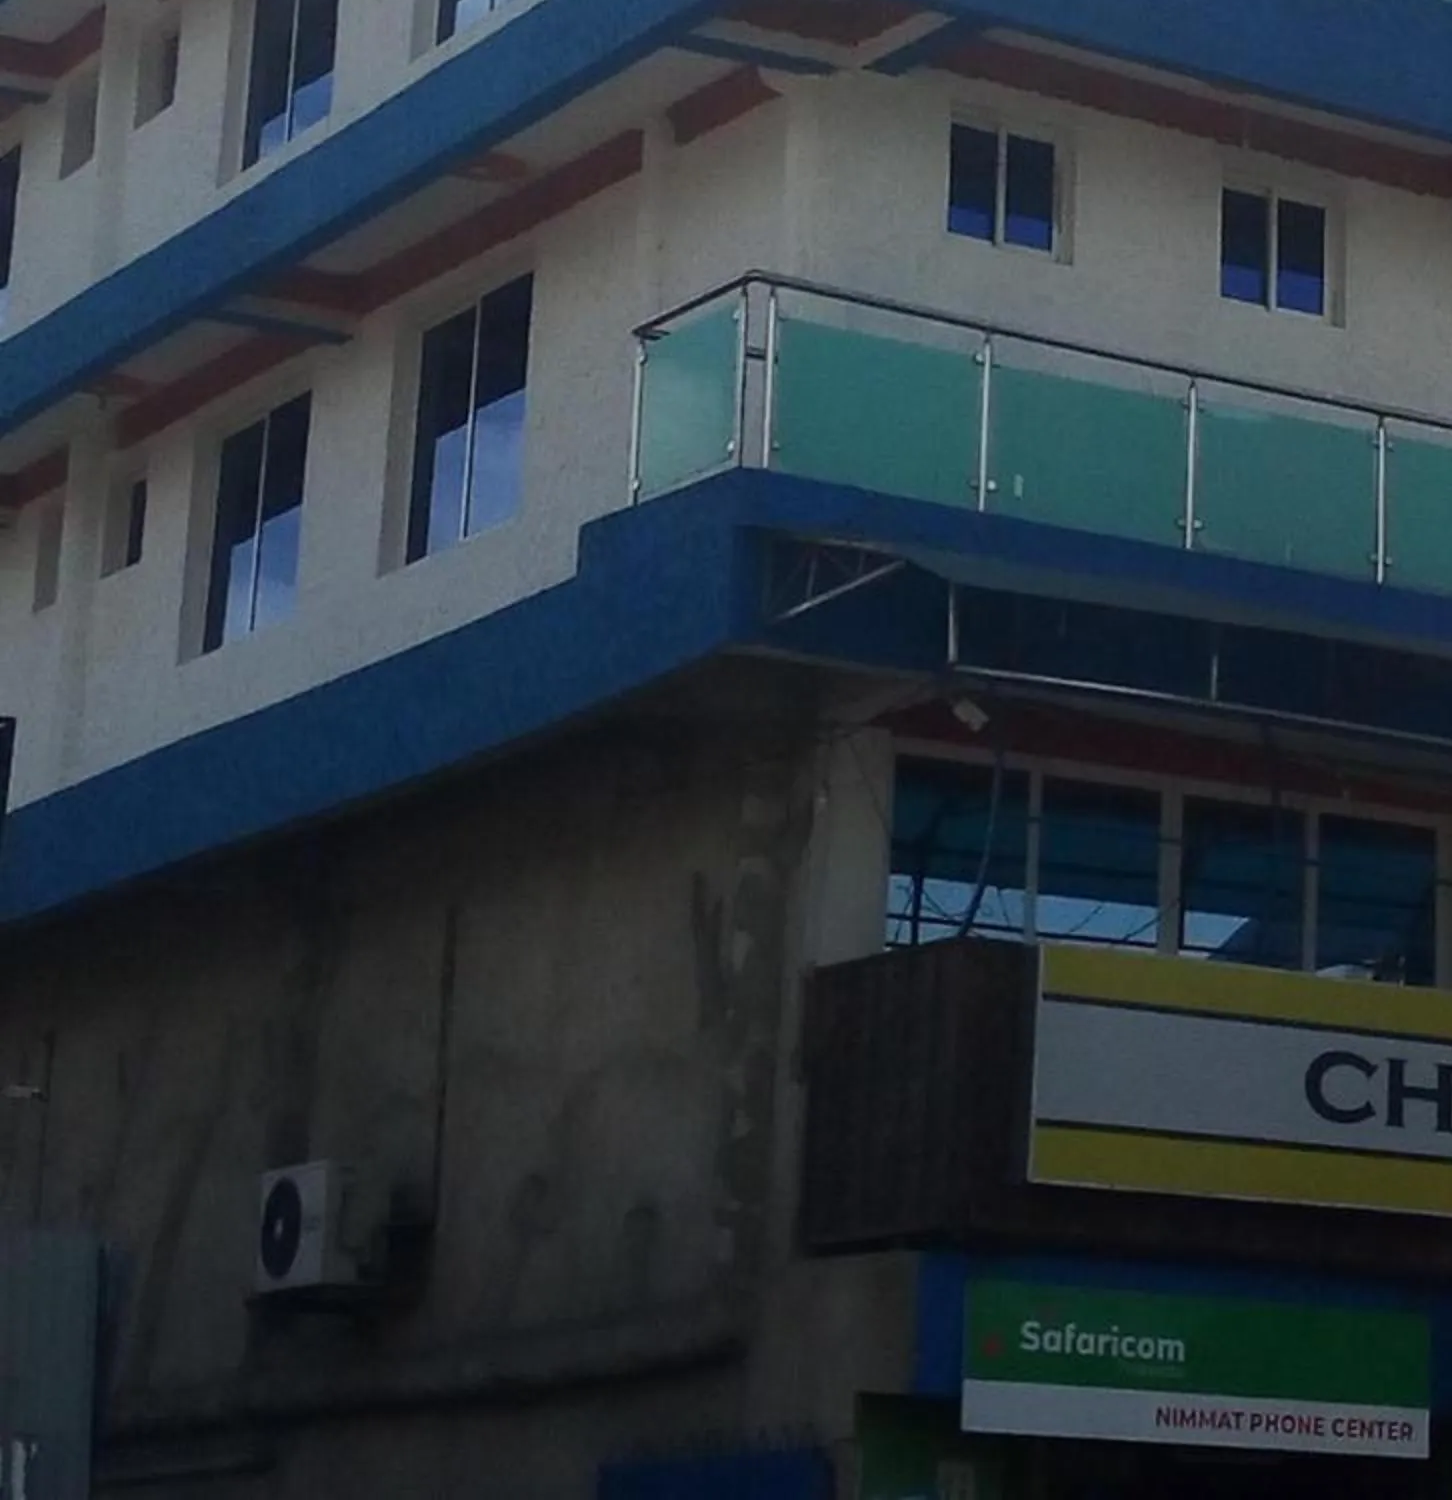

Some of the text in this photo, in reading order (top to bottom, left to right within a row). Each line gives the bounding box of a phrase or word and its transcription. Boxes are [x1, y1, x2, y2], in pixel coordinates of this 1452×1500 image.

[1019, 1319, 1186, 1363] Safaricom
[1154, 1405, 1415, 1442] NIMMAT PHONE CENTER
